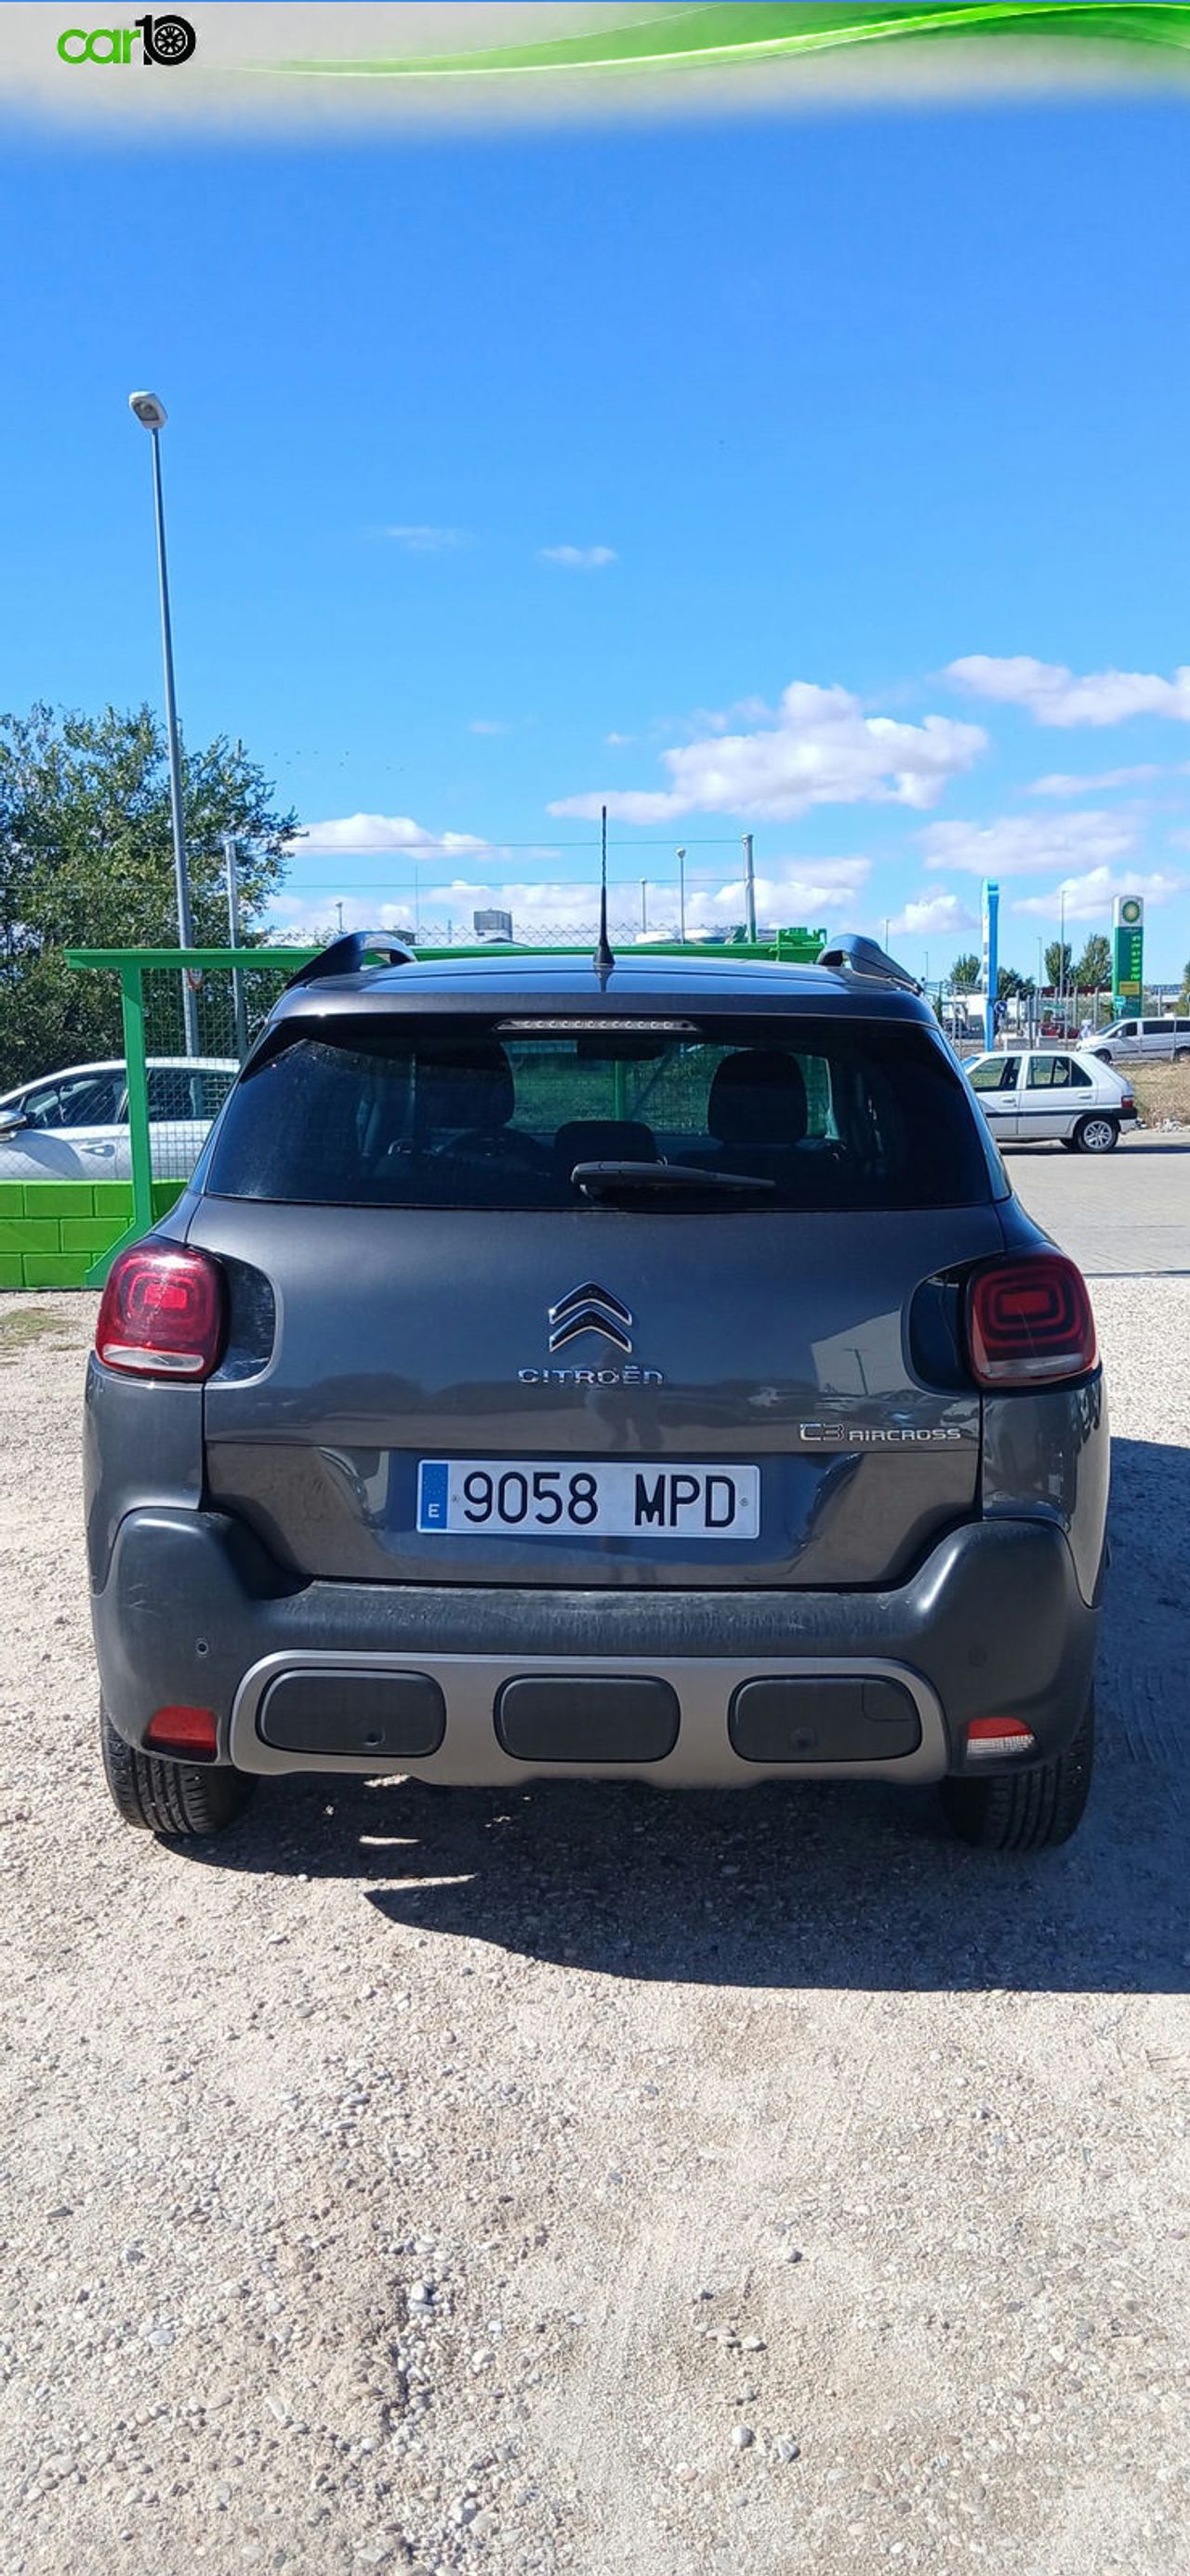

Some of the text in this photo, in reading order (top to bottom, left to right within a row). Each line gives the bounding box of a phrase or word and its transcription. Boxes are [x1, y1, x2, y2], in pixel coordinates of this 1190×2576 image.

[800, 1422, 962, 1442] C3 AIRCROSS
[464, 1471, 736, 1528] 9058 MPD
[428, 1503, 440, 1518] E
